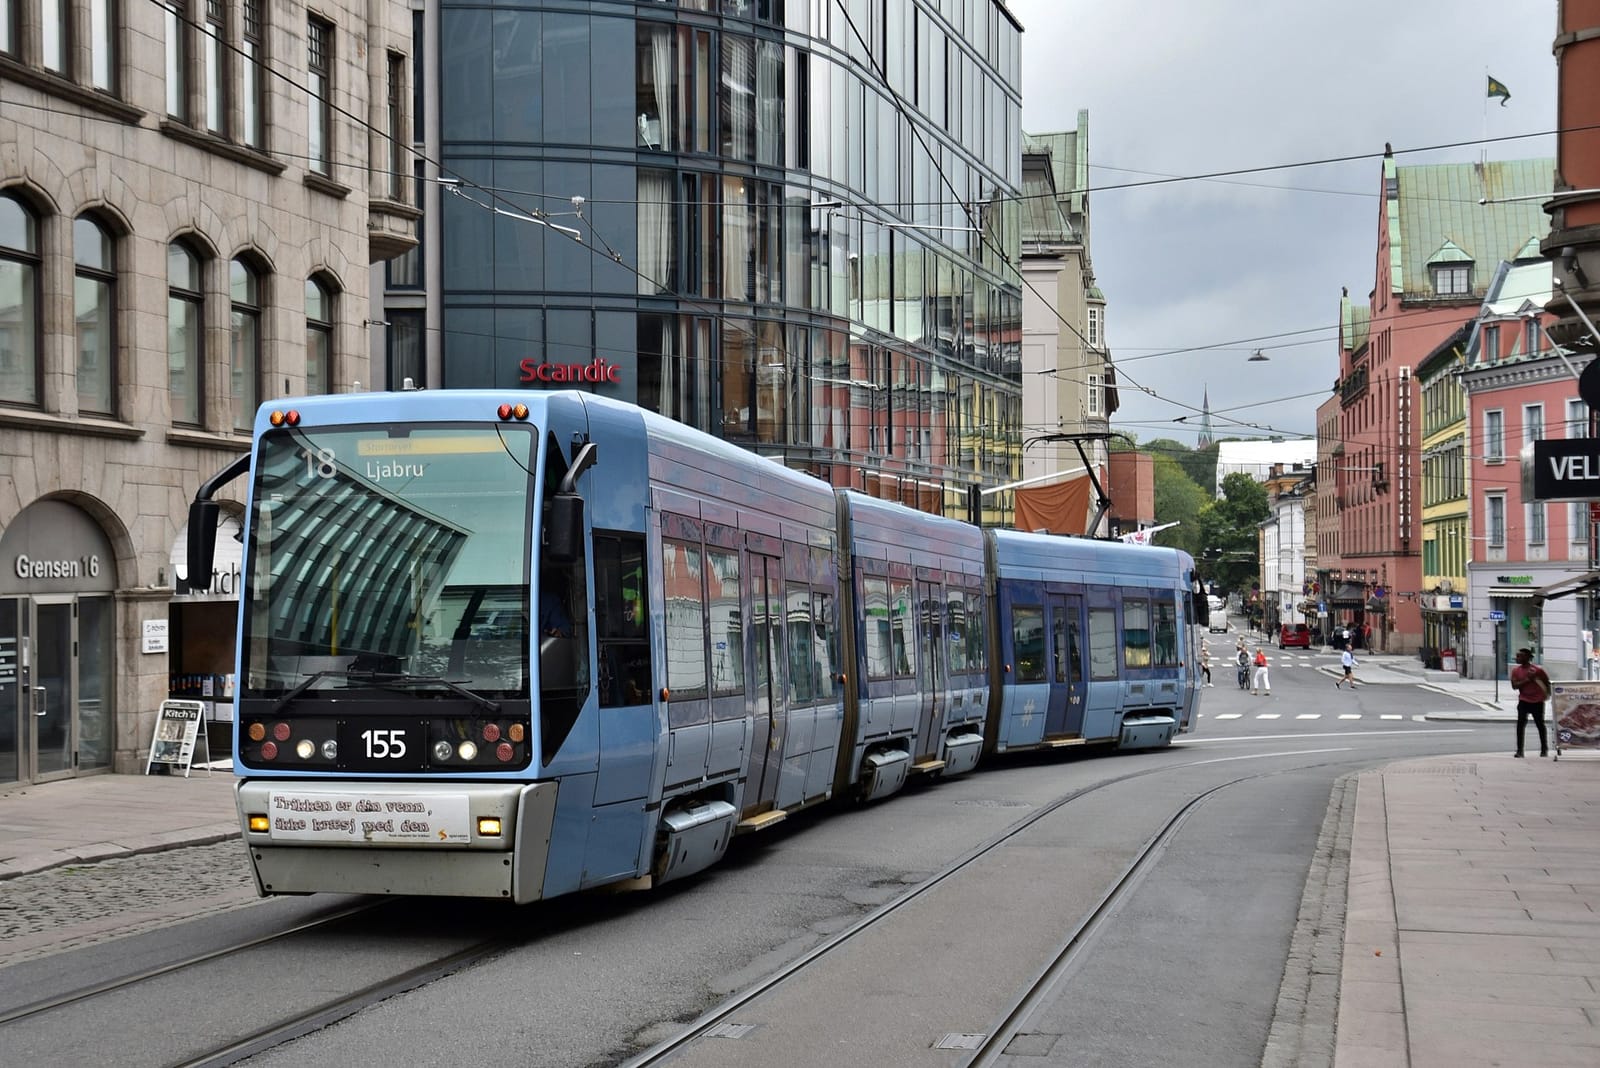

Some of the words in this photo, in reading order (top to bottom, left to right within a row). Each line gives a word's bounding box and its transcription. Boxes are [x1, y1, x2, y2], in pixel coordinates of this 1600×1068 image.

[520, 357, 622, 383] Scandic
[301, 448, 337, 479] 18
[366, 460, 424, 482] Ljabru
[1549, 455, 1600, 480] VEL
[16, 554, 79, 578] Grensen
[81, 555, 99, 577] 16
[361, 730, 406, 758] 155
[274, 796, 332, 812] Trikken
[336, 800, 352, 812] er
[356, 800, 382, 812] din
[275, 818, 306, 831] ikke
[312, 818, 355, 834] kræsj
[401, 820, 430, 832] den
